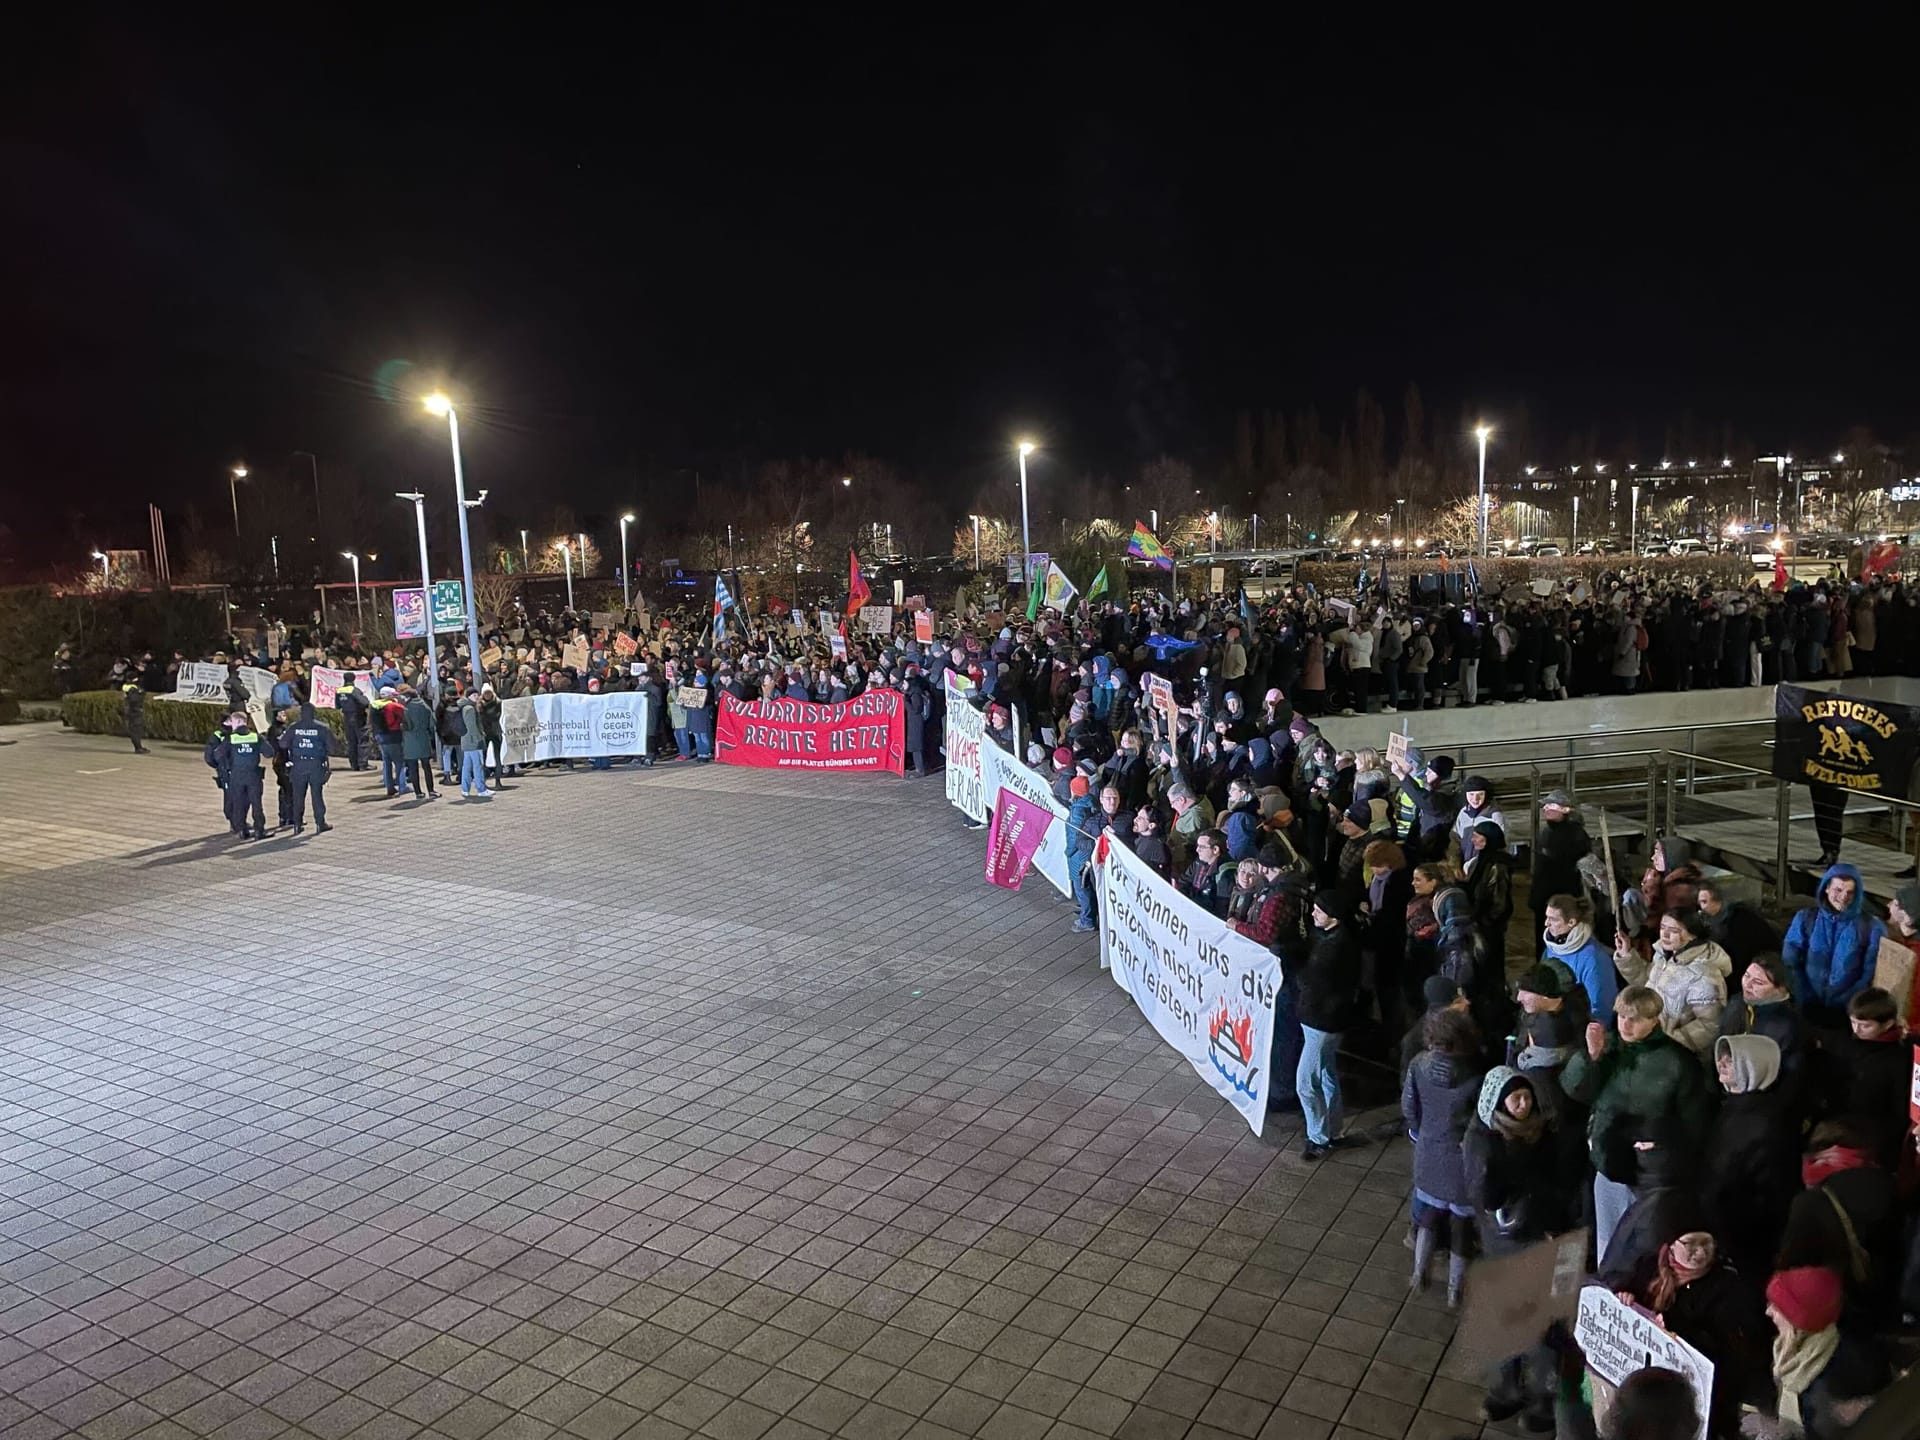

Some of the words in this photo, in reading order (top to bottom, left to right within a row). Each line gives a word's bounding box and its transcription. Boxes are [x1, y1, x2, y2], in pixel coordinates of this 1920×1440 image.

[605, 712, 631, 720] OMAS
[725, 696, 846, 724] SOLIDARISCH
[1802, 700, 1898, 739] REFUGEES
[513, 738, 531, 747] zur
[566, 731, 590, 741] wird
[539, 719, 590, 731] Schneeball
[601, 731, 636, 740] RECHTS
[744, 725, 817, 752] RECHTE
[830, 725, 889, 752] HETZE
[1805, 760, 1883, 790] WELCOME
[1136, 879, 1188, 946] können
[1198, 938, 1230, 978] uns
[1242, 969, 1273, 1010] die
[1163, 949, 1203, 1003] nicht
[1142, 963, 1197, 1040] leisten!
[1600, 1299, 1629, 1333] Bitte
[1632, 1319, 1663, 1355] leiten
[1665, 1342, 1680, 1368] Sie
